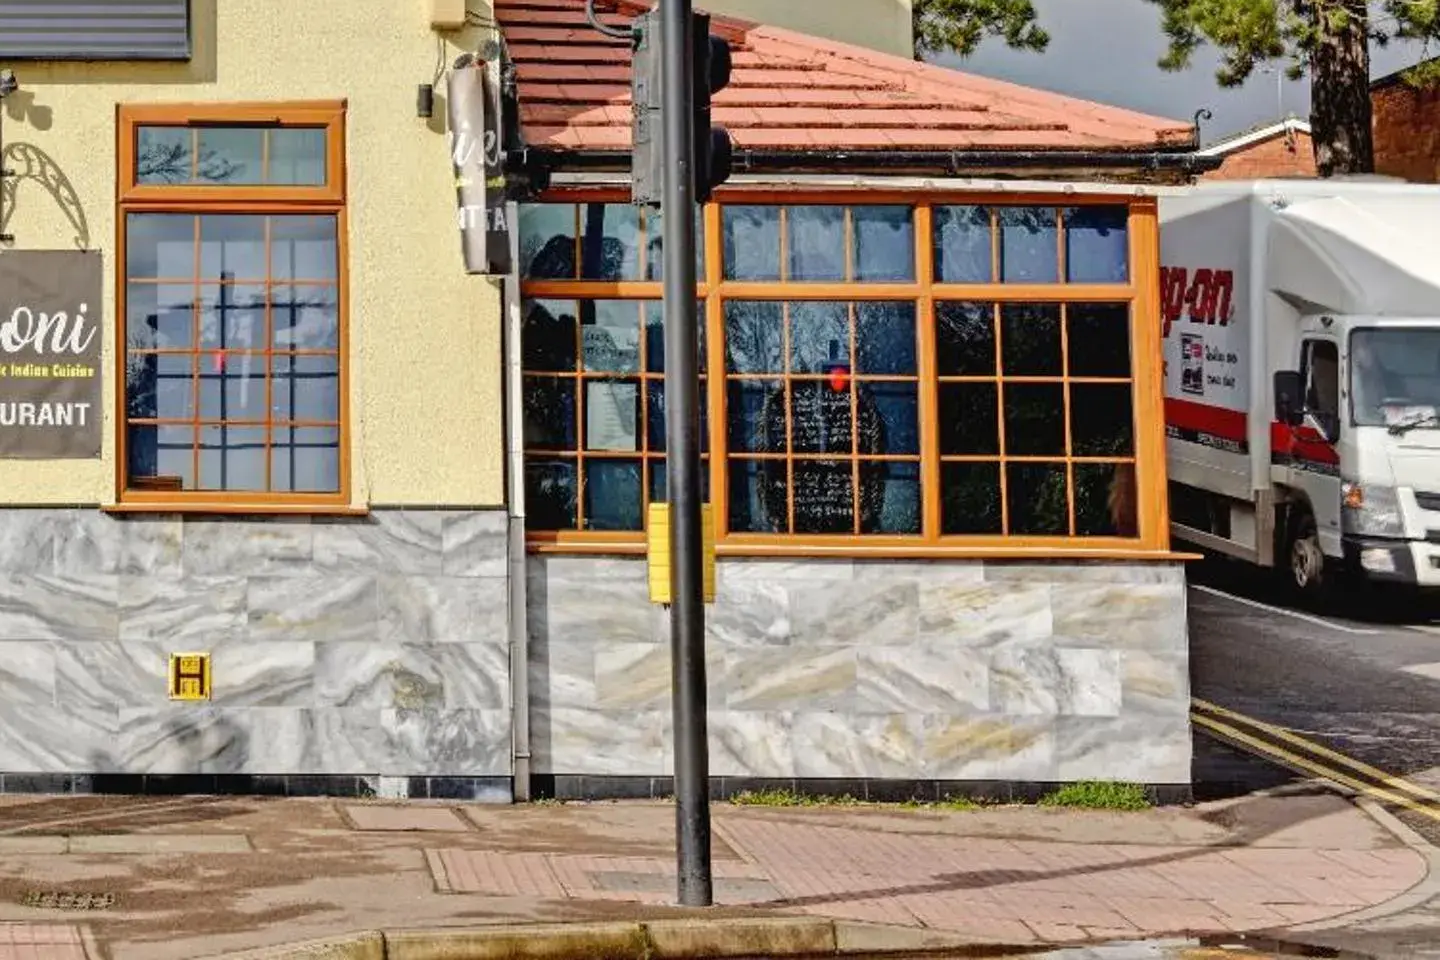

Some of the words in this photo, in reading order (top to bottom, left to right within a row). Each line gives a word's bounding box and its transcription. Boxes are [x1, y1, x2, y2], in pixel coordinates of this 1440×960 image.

[10, 363, 49, 377] Indian
[52, 363, 95, 378] Cuisine
[174, 656, 205, 695] H
